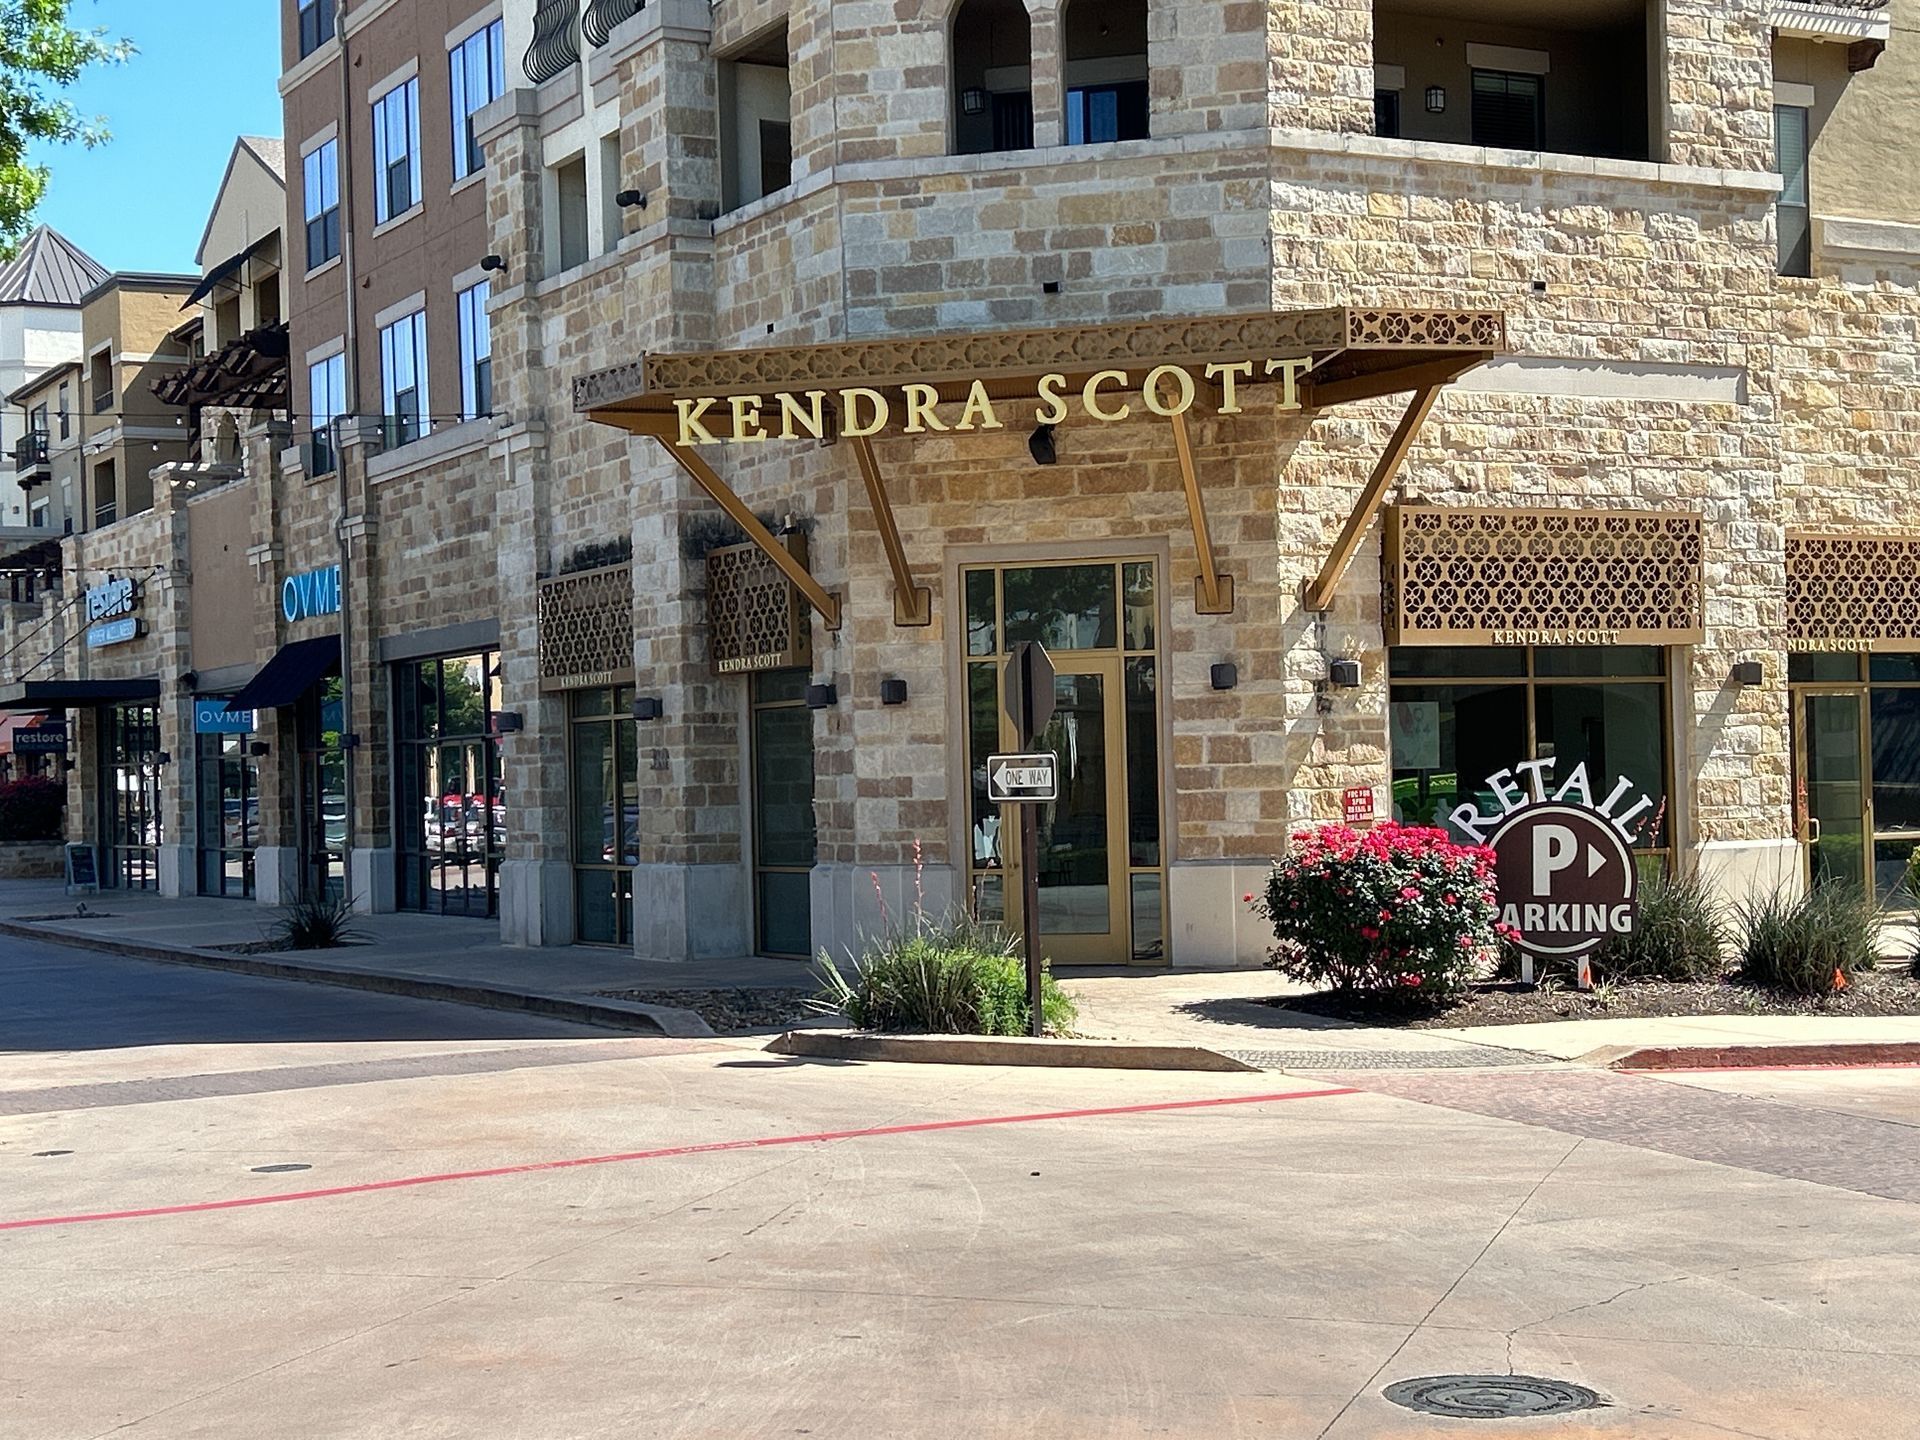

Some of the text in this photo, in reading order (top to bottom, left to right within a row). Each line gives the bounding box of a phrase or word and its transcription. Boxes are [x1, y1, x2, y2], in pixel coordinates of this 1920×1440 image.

[673, 356, 1313, 446] KENDRA SCOTT
[283, 565, 341, 622] OVME
[1493, 629, 1620, 644] KENDRA SCOTT
[1787, 638, 1875, 652] NDRA SCOTT
[718, 652, 782, 673] KENDRA SCOTT
[560, 670, 613, 688] KENDRA SCOTT
[200, 710, 250, 724] OVME
[15, 731, 64, 744] restore
[1005, 769, 1048, 785] ONE WAY
[1449, 757, 1653, 845] RETAIL
[1532, 824, 1578, 896] P
